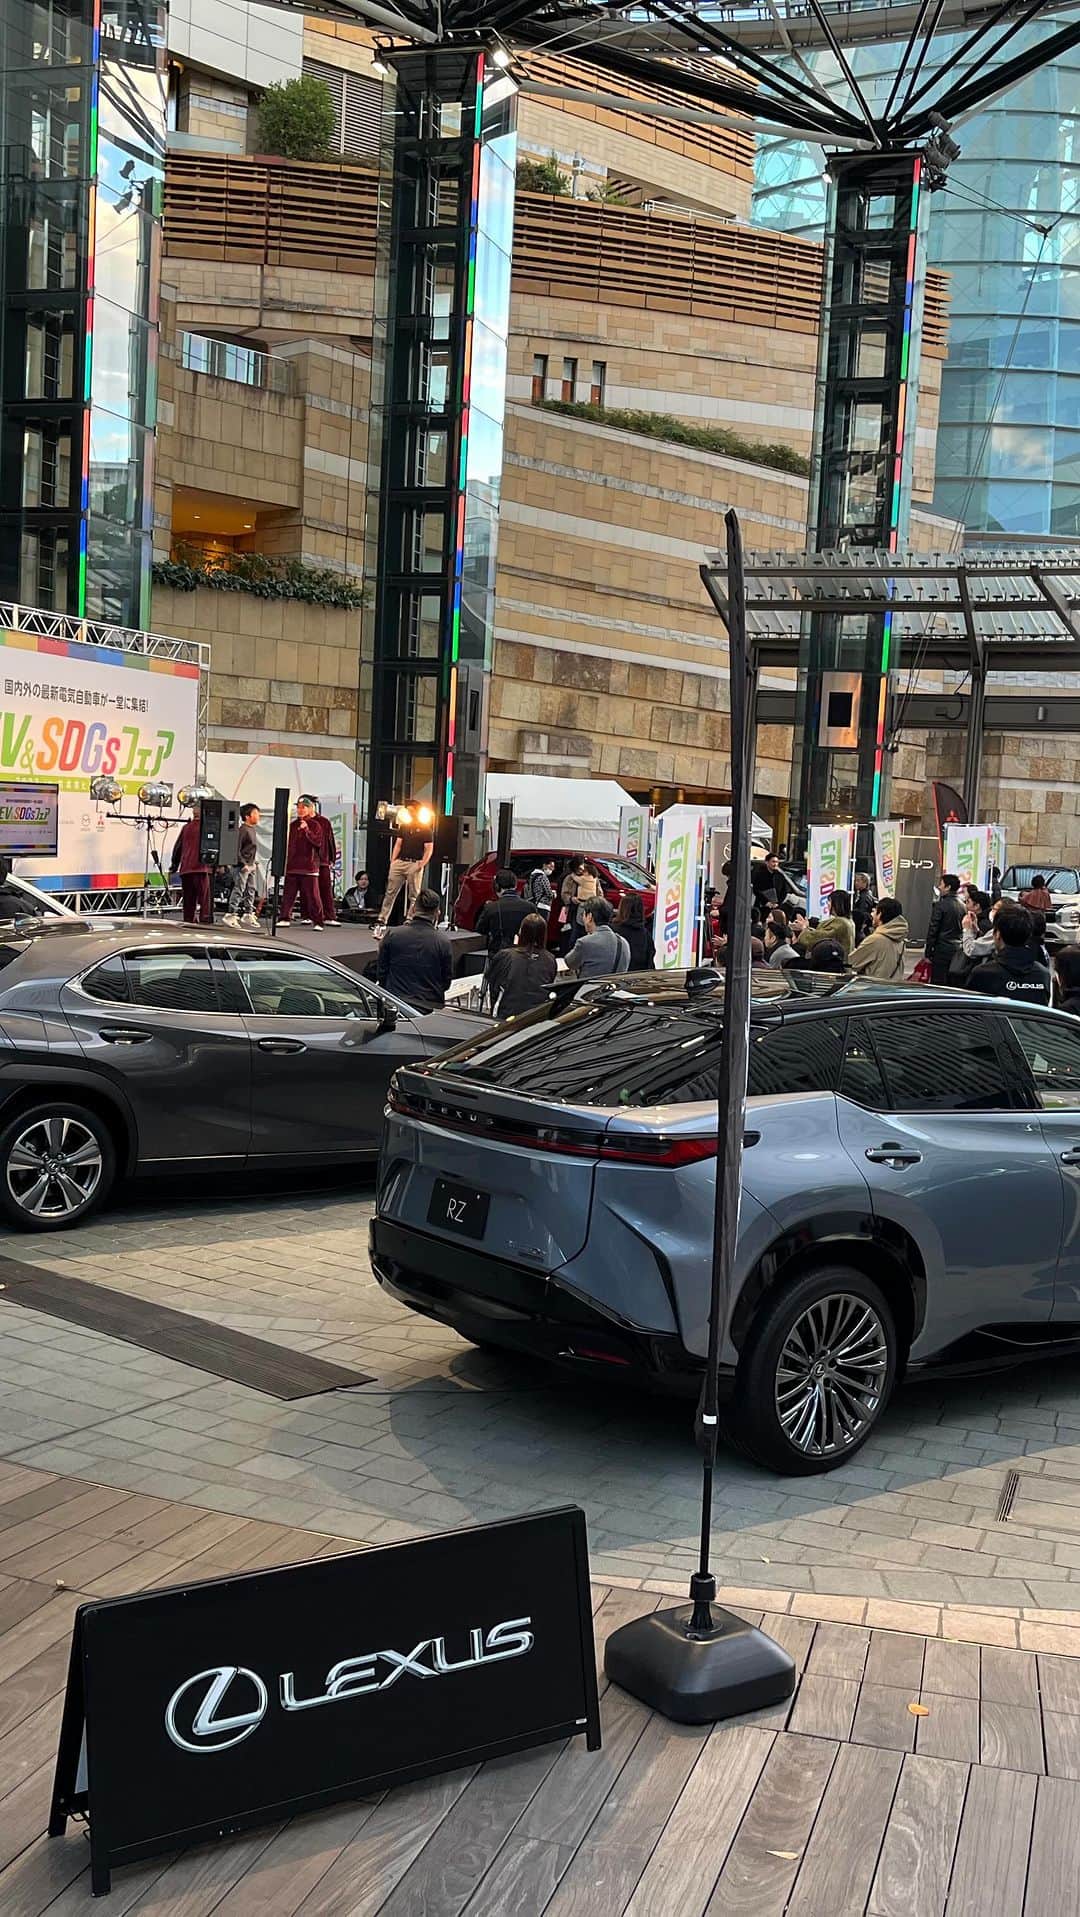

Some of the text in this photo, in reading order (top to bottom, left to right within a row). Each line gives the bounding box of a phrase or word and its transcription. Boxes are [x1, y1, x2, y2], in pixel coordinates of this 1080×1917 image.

[0, 711, 175, 776] V&SDGsフェア
[899, 859, 934, 869] BYD
[428, 1102, 494, 1125] LEXUS
[446, 1198, 467, 1223] RZ
[279, 1616, 535, 1712] LEXUS
